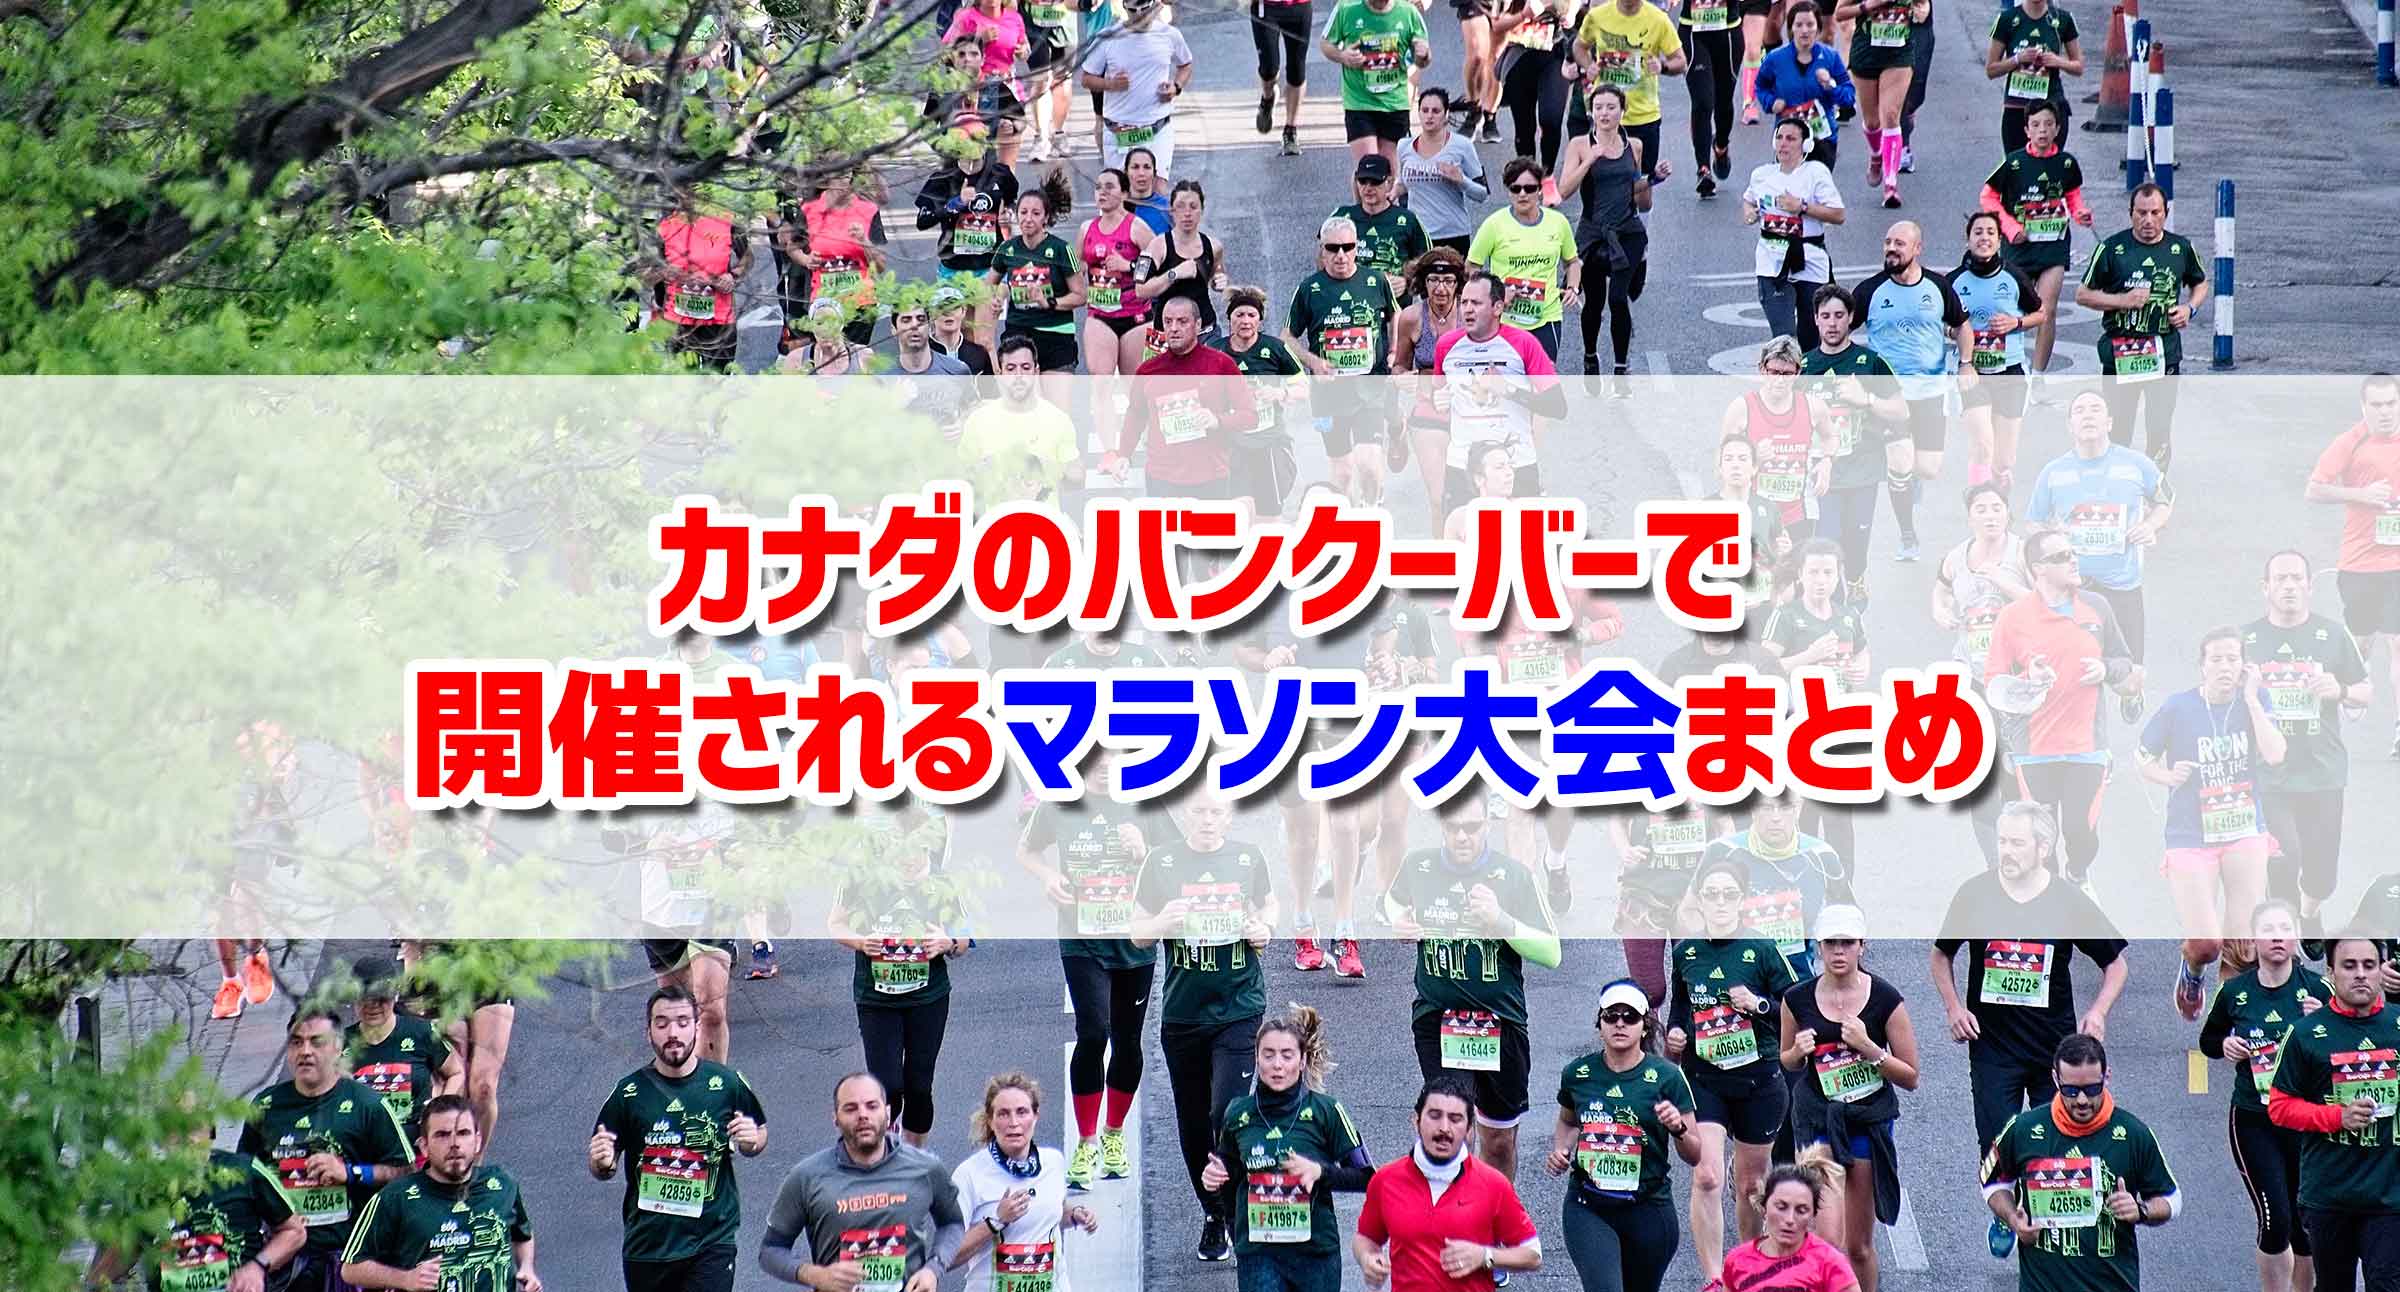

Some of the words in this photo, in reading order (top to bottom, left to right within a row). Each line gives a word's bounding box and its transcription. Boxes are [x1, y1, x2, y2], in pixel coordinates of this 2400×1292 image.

[1340, 355, 1362, 367] 40802
[2200, 763, 2227, 782] FOR
[2229, 758, 2248, 777] THE
[1067, 844, 1102, 854] MADRID
[1423, 910, 1459, 921] MADRID
[2001, 976, 2032, 993] 42572
[1460, 1042, 1488, 1058] 41644
[645, 1134, 682, 1145] MADRID
[660, 1184, 692, 1202] 42859
[303, 1196, 334, 1211] 42384
[2049, 1197, 2082, 1213] 42659
[429, 1235, 470, 1249] MADRID
[185, 1276, 217, 1291] 40821
